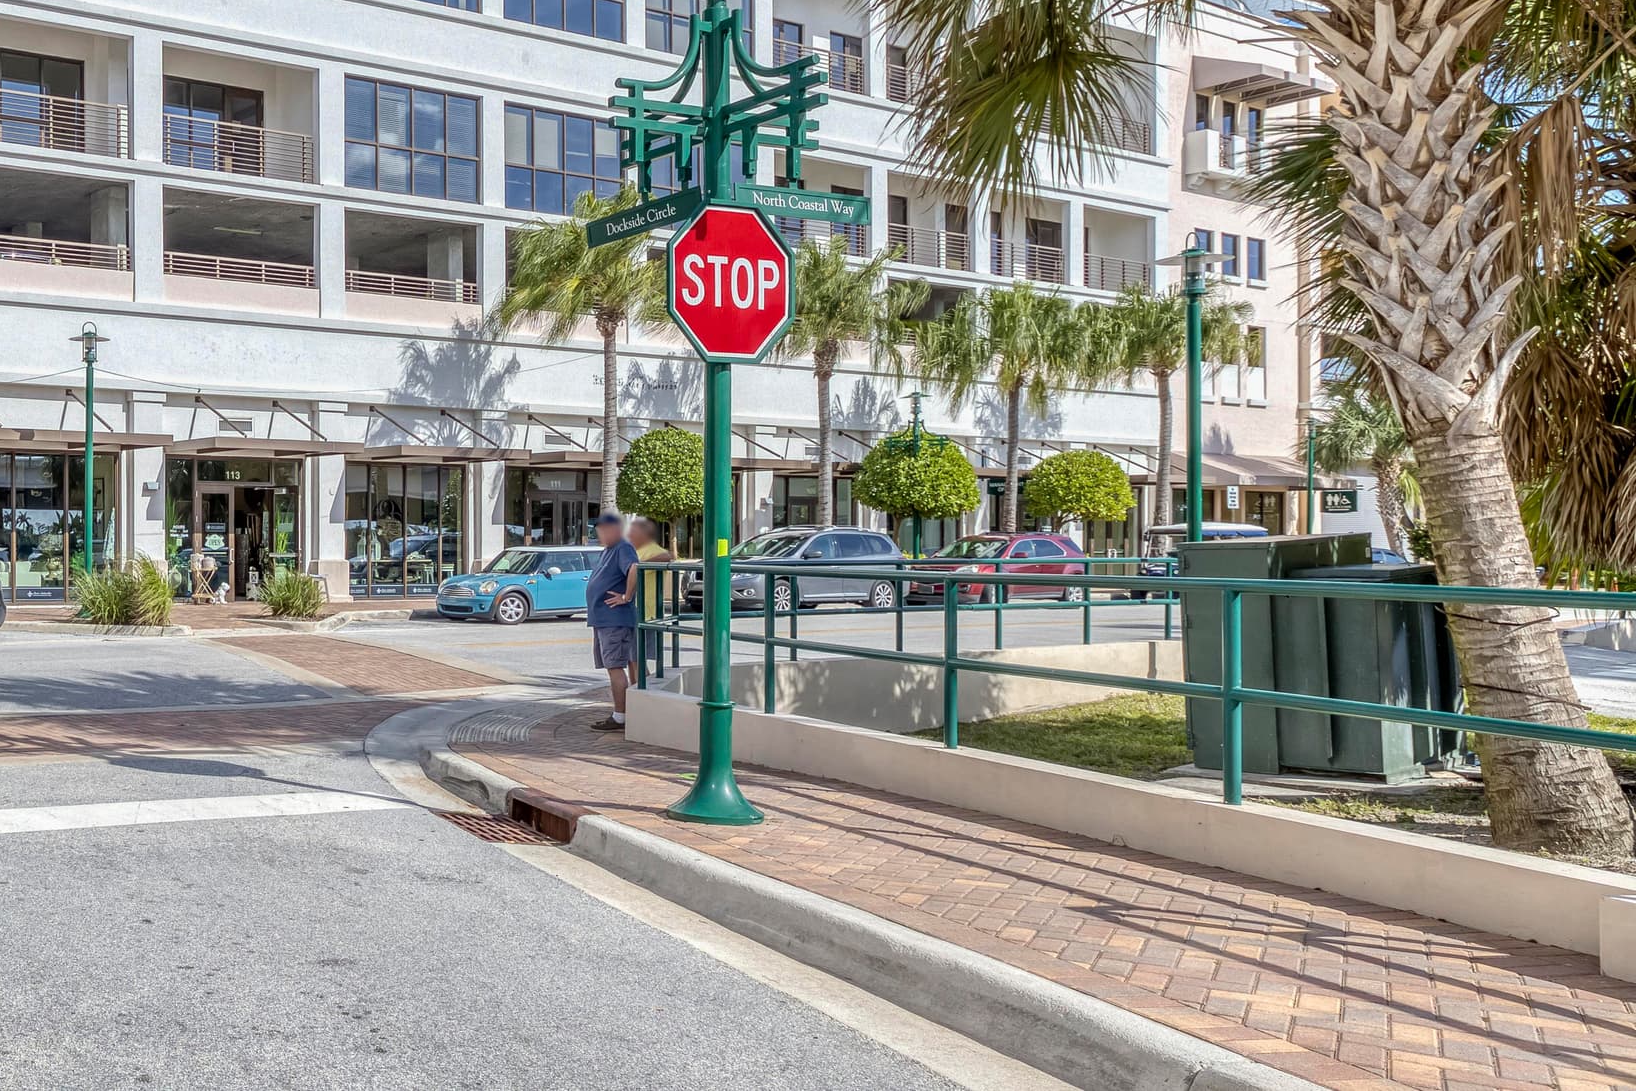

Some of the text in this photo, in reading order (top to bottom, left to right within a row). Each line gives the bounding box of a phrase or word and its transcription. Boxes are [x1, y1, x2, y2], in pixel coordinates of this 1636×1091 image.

[752, 191, 854, 217] North Coastal Way
[606, 204, 677, 236] Dockside Circle
[681, 253, 780, 311] STOP
[225, 470, 241, 480] 113
